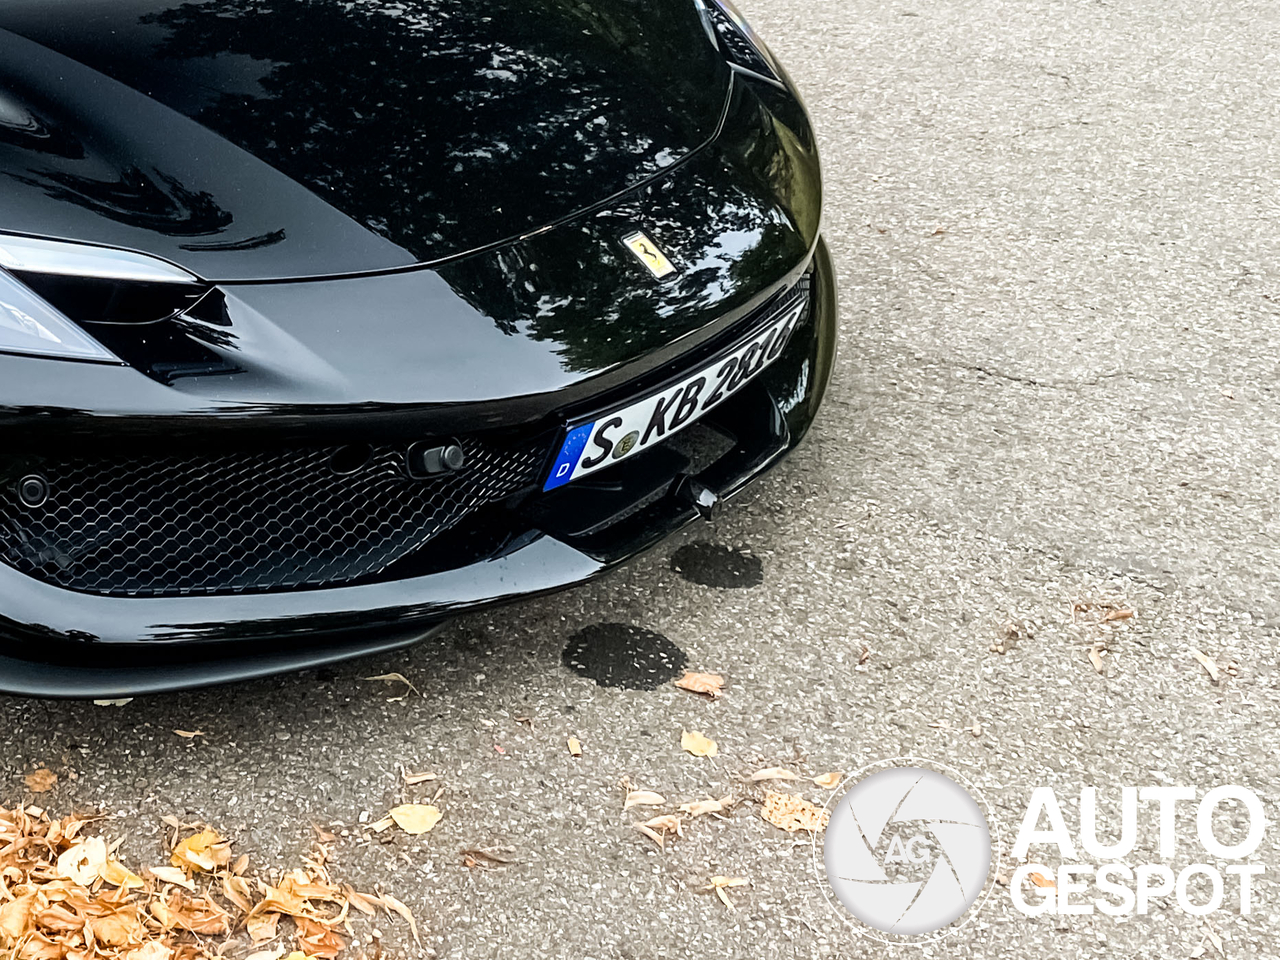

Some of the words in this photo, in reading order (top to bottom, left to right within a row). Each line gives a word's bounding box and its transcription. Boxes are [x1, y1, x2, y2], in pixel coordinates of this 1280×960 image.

[581, 417, 623, 469] S
[639, 376, 707, 445] KB
[701, 311, 798, 411] 2816
[556, 462, 570, 478] D
